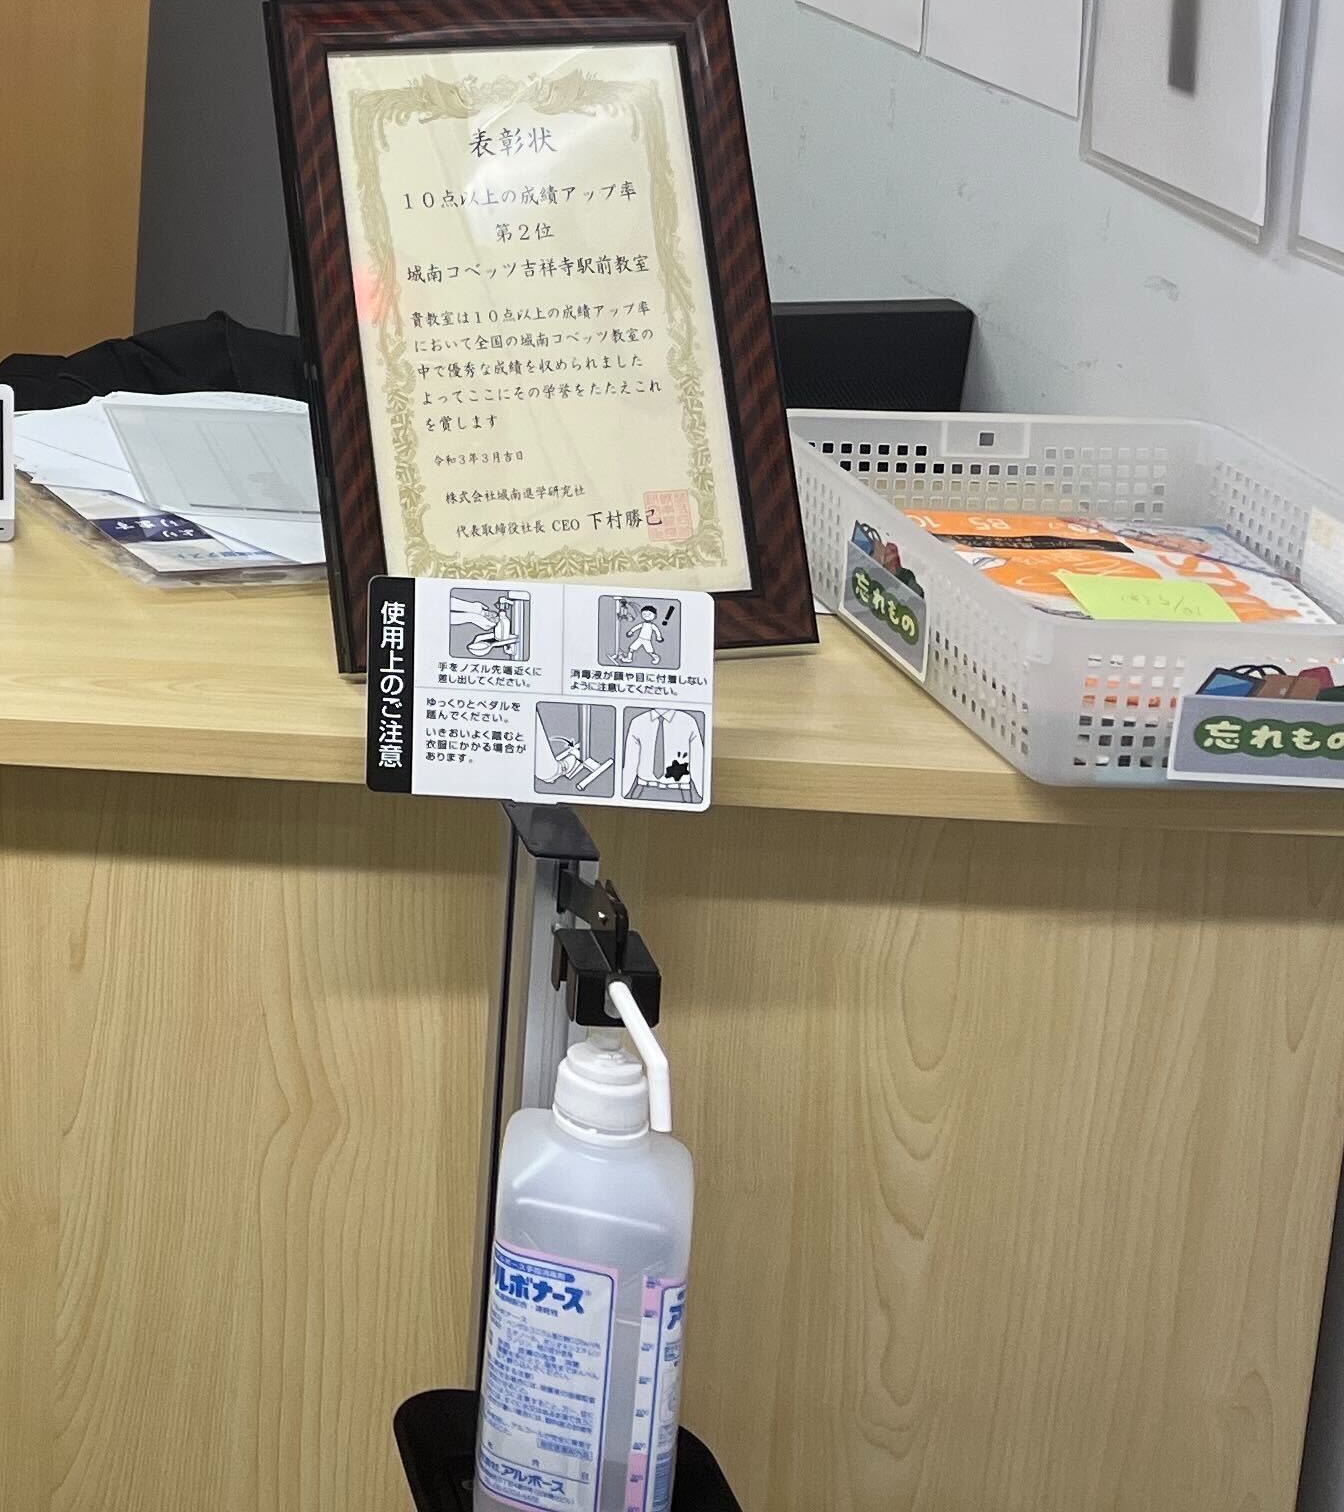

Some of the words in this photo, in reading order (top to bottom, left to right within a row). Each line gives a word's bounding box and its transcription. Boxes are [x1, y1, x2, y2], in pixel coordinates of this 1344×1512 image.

[470, 127, 557, 159] 表彰状
[403, 180, 638, 211] 10点以上の成績アップ率
[495, 222, 554, 243] 第2位
[407, 253, 649, 283] 城南コベッツ吉祥寺駅前教室
[412, 300, 651, 328] 貴教室は10点以上の成績アップ率
[414, 328, 654, 353] において全国の城南コベッツ教室の
[418, 354, 644, 379] 中で優秀な成績を収められました
[422, 379, 662, 407] よってここにその栄誉をたたえこれ
[424, 413, 498, 433] を賞します
[434, 450, 524, 467] 令和3年3月吉日
[445, 486, 585, 505] 株式会社城南進学研究社
[456, 518, 544, 538] 代表取締役社長
[551, 517, 580, 532] CEO
[588, 508, 663, 531] 下村勝己
[854, 568, 915, 639] 忘れもの
[438, 662, 542, 676] 手をノズル先端近くに
[570, 669, 707, 686] 消毒液が顔や目に付着しない
[378, 601, 406, 768] 使用上のご注意
[438, 674, 531, 688] 差し出してください。
[570, 682, 679, 696] ように注意してください。
[426, 698, 521, 711] ゆっくりとペダルを
[426, 710, 508, 724] 踏んでください。
[426, 727, 524, 742] いきおいよく踏むと
[1203, 719, 1344, 751] 忘れもの
[426, 740, 527, 754] 衣服にかかる場合が
[426, 752, 474, 764] あります。
